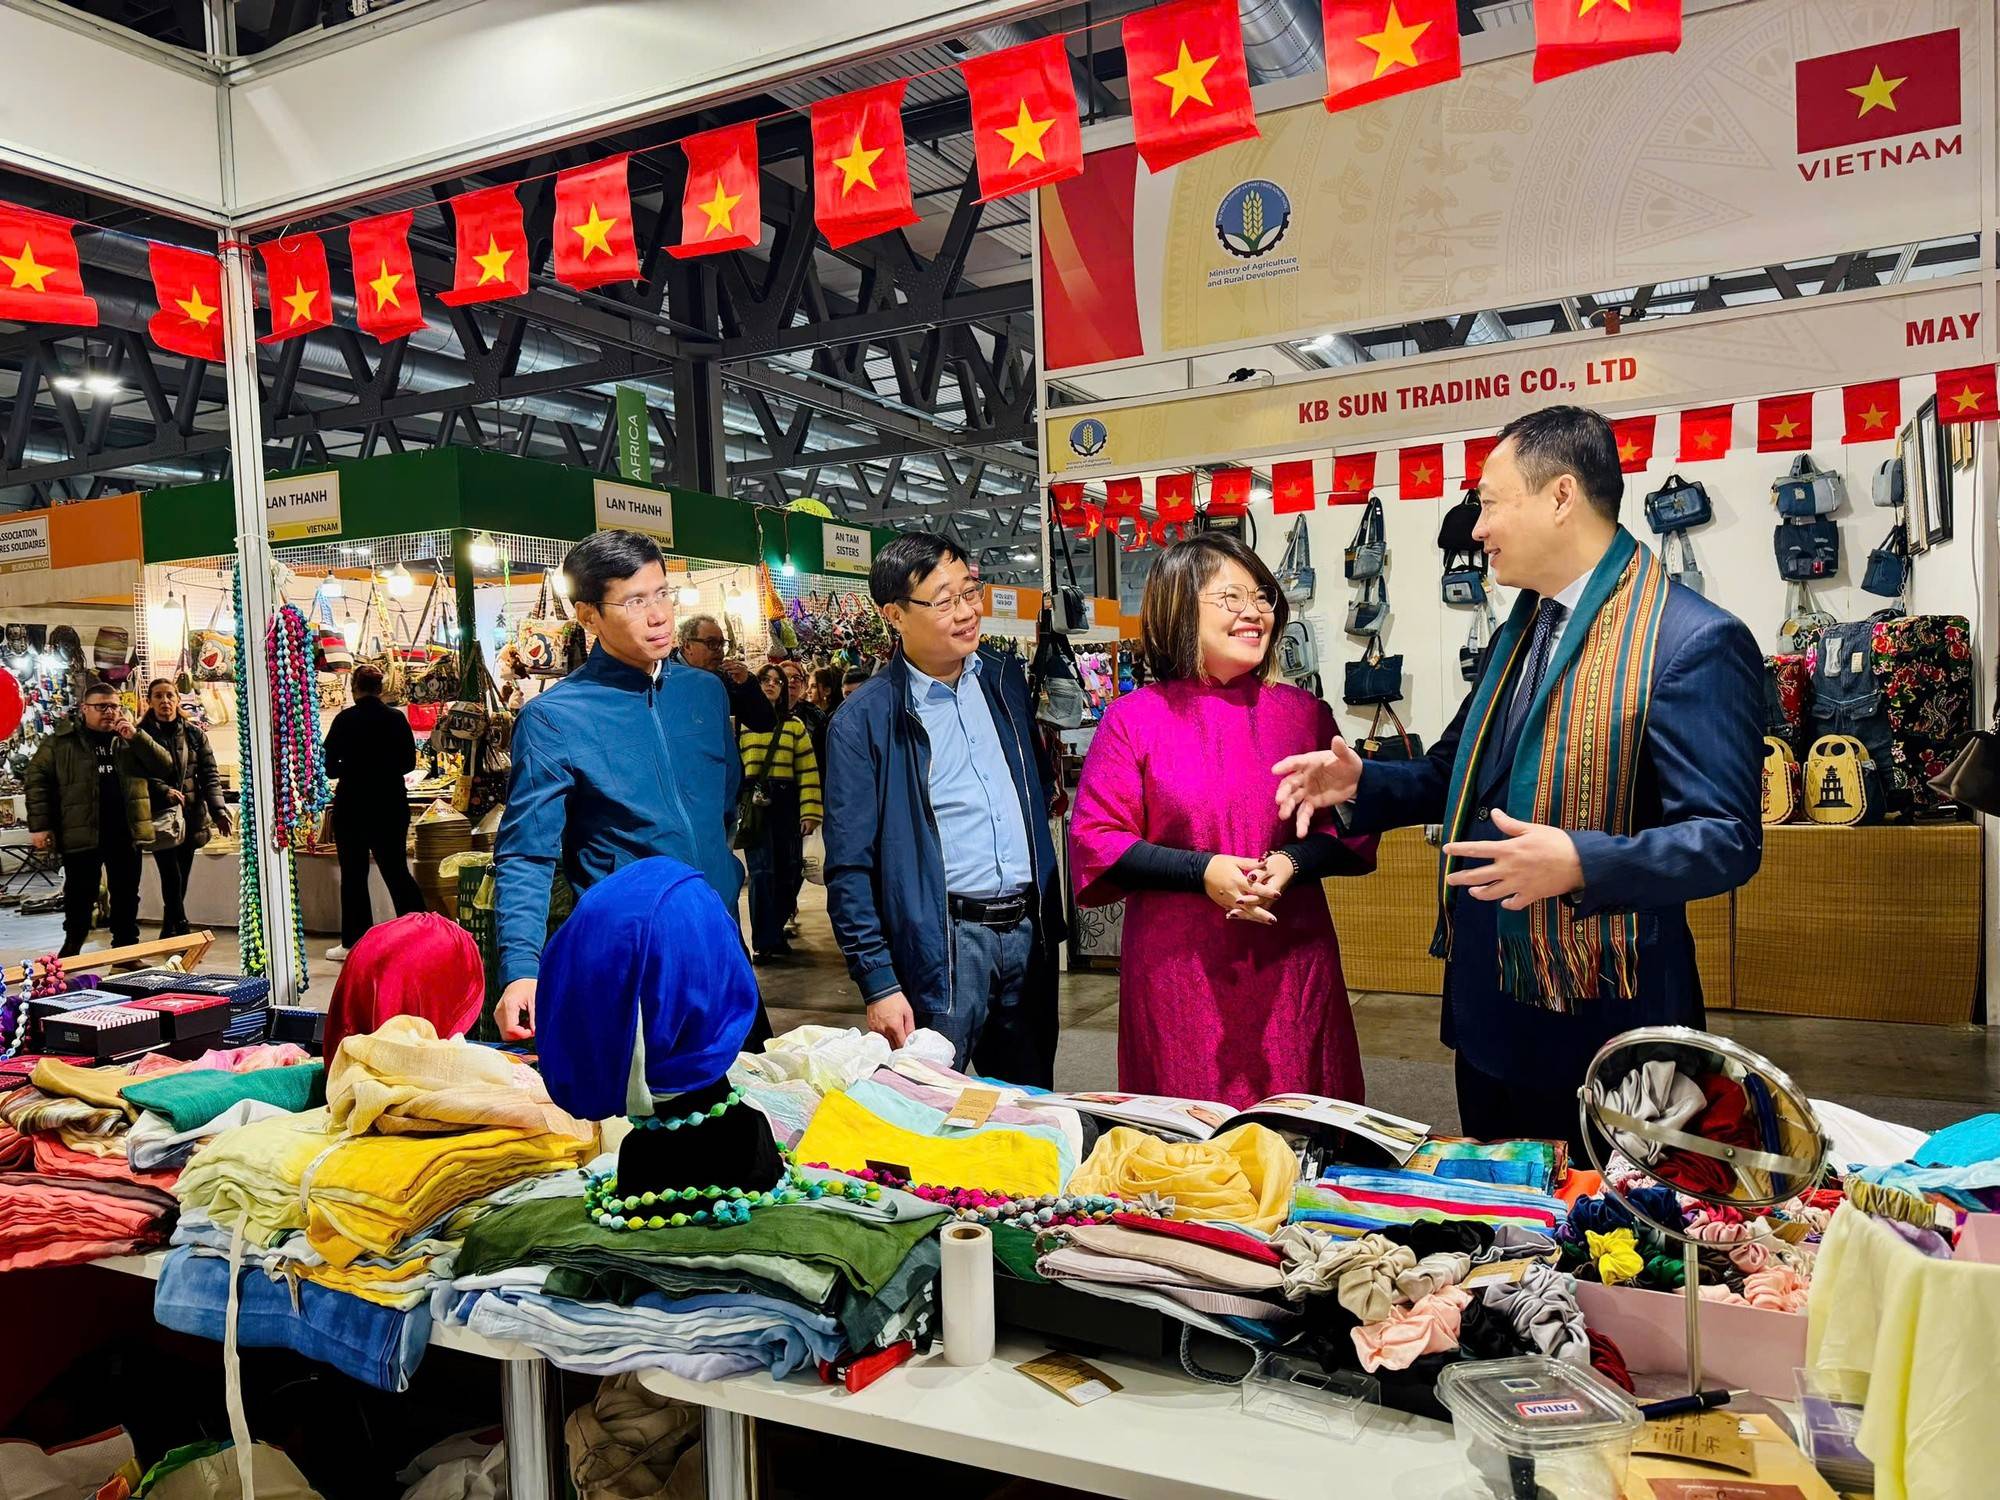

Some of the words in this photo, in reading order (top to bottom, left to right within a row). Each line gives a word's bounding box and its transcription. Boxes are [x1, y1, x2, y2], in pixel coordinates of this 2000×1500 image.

[1797, 134, 1962, 182] VIETNAM
[1207, 279, 1222, 287] and
[1223, 274, 1244, 285] Rural
[1246, 265, 1300, 281] Development
[1209, 265, 1241, 278] Ministry
[1242, 262, 1251, 272] of
[1252, 256, 1297, 271] Agriculture
[1906, 312, 1981, 347] MAY
[1298, 400, 1329, 424] KB
[1338, 391, 1388, 418] SUN
[1396, 373, 1510, 410] TRADING
[1520, 367, 1576, 393] CO.,
[1586, 357, 1637, 386] LTD
[627, 414, 642, 480] AFRICA
[266, 495, 287, 509] LAN
[289, 489, 327, 506] THANH
[605, 497, 626, 511] LAN
[628, 500, 662, 517] THANH
[0, 527, 38, 542] SSOCIATION
[306, 522, 339, 534] VIETNAM
[835, 531, 845, 541] AN
[846, 533, 860, 544] TAM
[11, 539, 46, 552] SOLIDAIRES
[836, 545, 860, 557] SISTERS
[1526, 1401, 1579, 1414] FATINA
